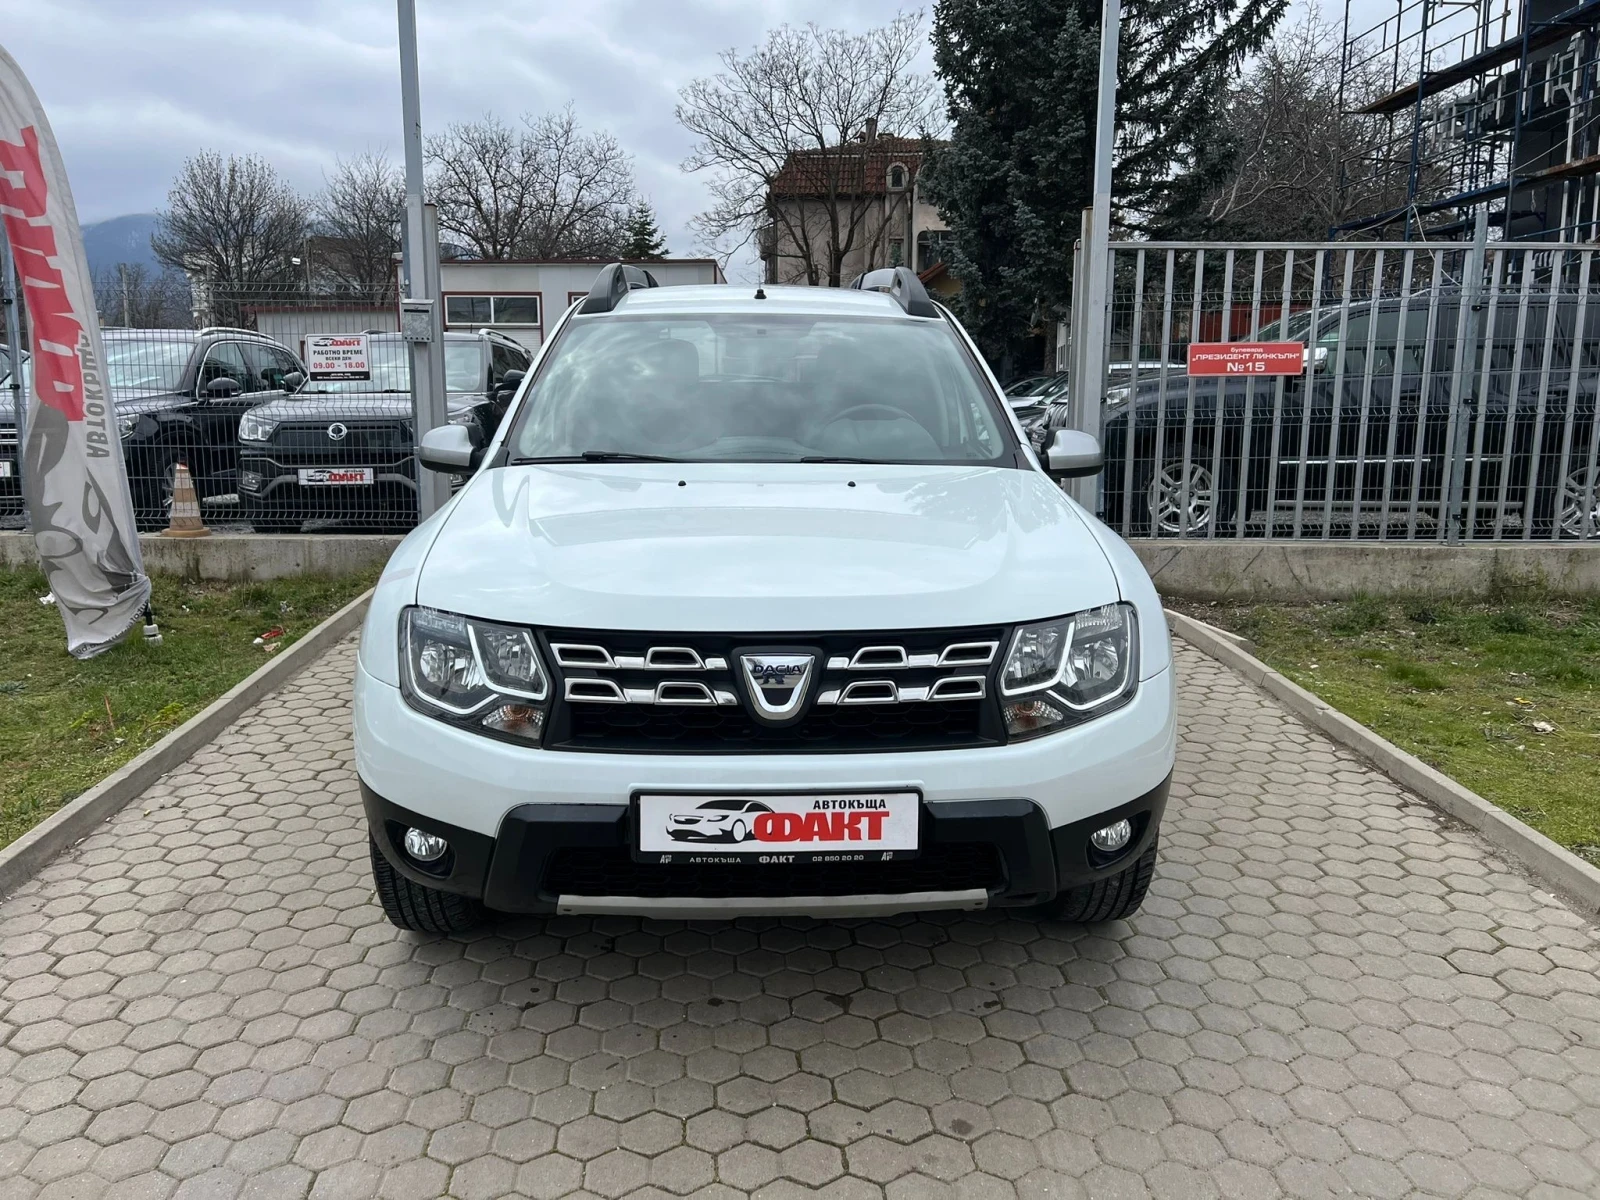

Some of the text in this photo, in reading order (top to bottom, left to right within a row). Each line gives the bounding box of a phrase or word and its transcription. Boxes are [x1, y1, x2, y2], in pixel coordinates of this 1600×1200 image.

[754, 664, 802, 674] DACIA
[813, 799, 886, 810] АВТОКЪЩА
[753, 811, 890, 842] ФАКТ
[758, 855, 795, 863] ФАКТ
